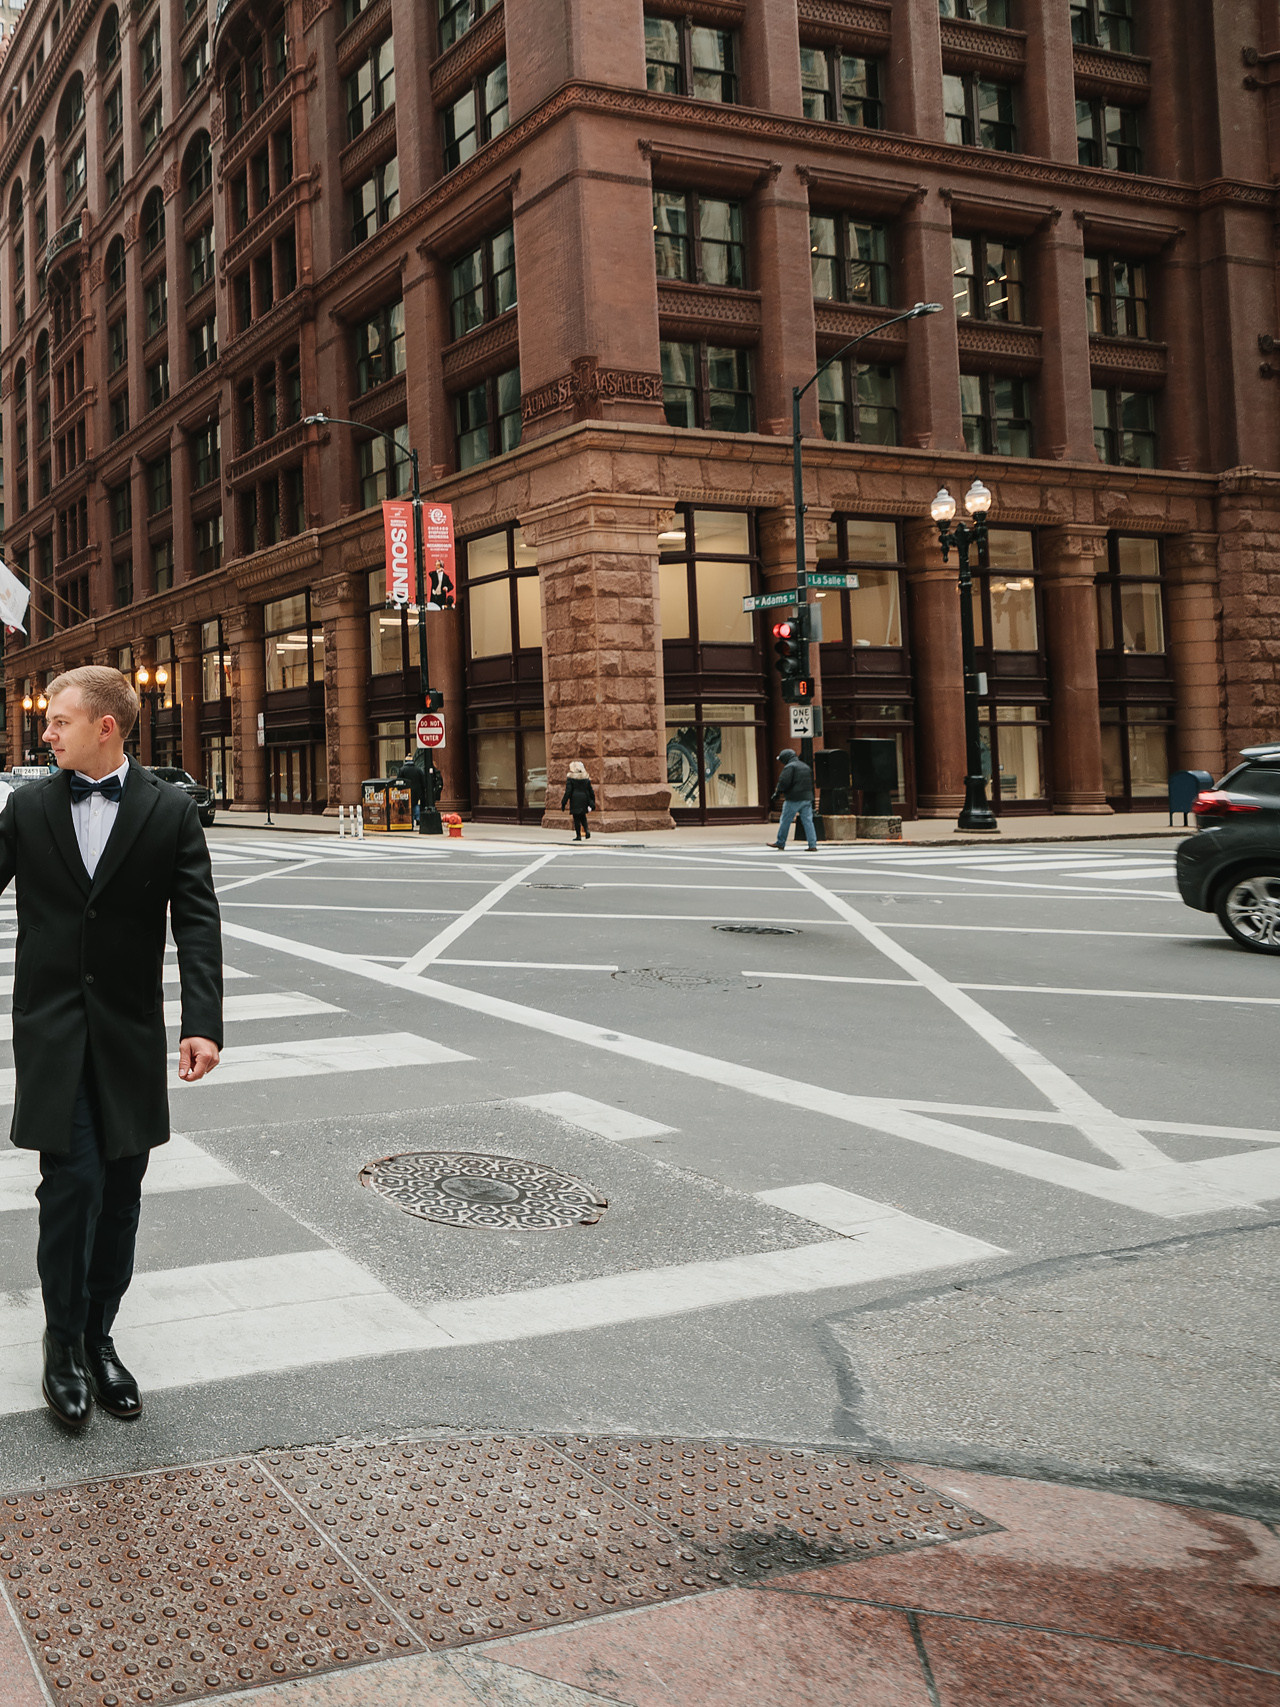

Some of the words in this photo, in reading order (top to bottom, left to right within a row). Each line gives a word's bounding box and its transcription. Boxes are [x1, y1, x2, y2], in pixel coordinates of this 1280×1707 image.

[391, 528, 409, 603] SOUND
[812, 575, 822, 584] La
[823, 575, 841, 585] Salle
[761, 595, 788, 606] Adams
[792, 709, 810, 717] ONE
